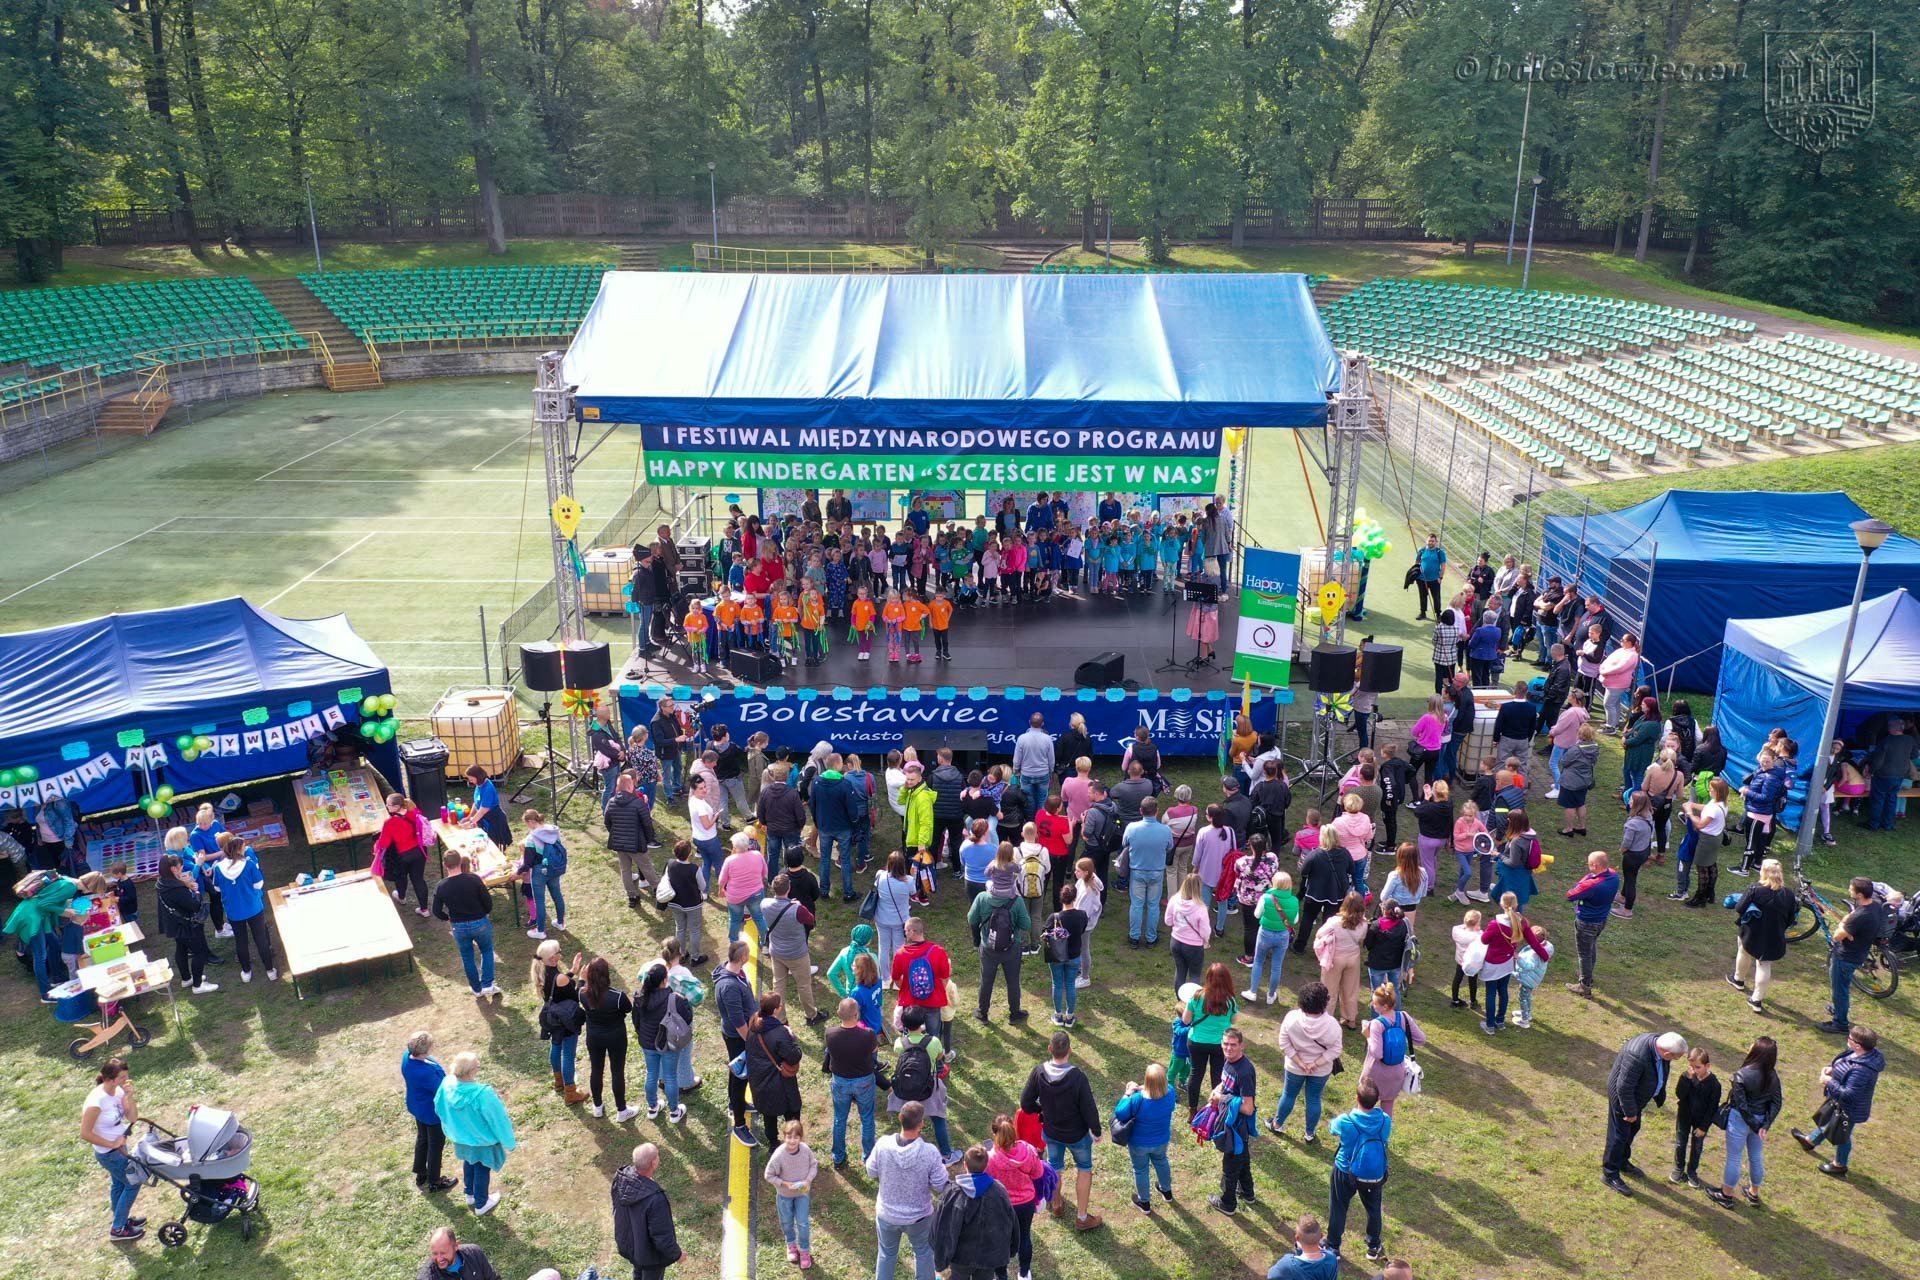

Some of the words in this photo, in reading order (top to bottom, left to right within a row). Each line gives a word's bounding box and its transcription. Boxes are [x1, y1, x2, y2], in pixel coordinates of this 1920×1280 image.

[662, 426, 670, 444] I
[677, 427, 791, 447] FESTIWAL
[798, 428, 1071, 450] MIĘDZYNARODOWEGO
[1078, 431, 1216, 450] PROGRAMU
[650, 460, 726, 479] HAPPY
[733, 461, 915, 482] KINDERGARTEN
[1064, 464, 1116, 483] JEST
[1124, 465, 1146, 483] W
[1245, 574, 1285, 594] Happy
[830, 730, 903, 741] miasto
[0, 756, 111, 800] OWANIE
[131, 740, 160, 760] NA
